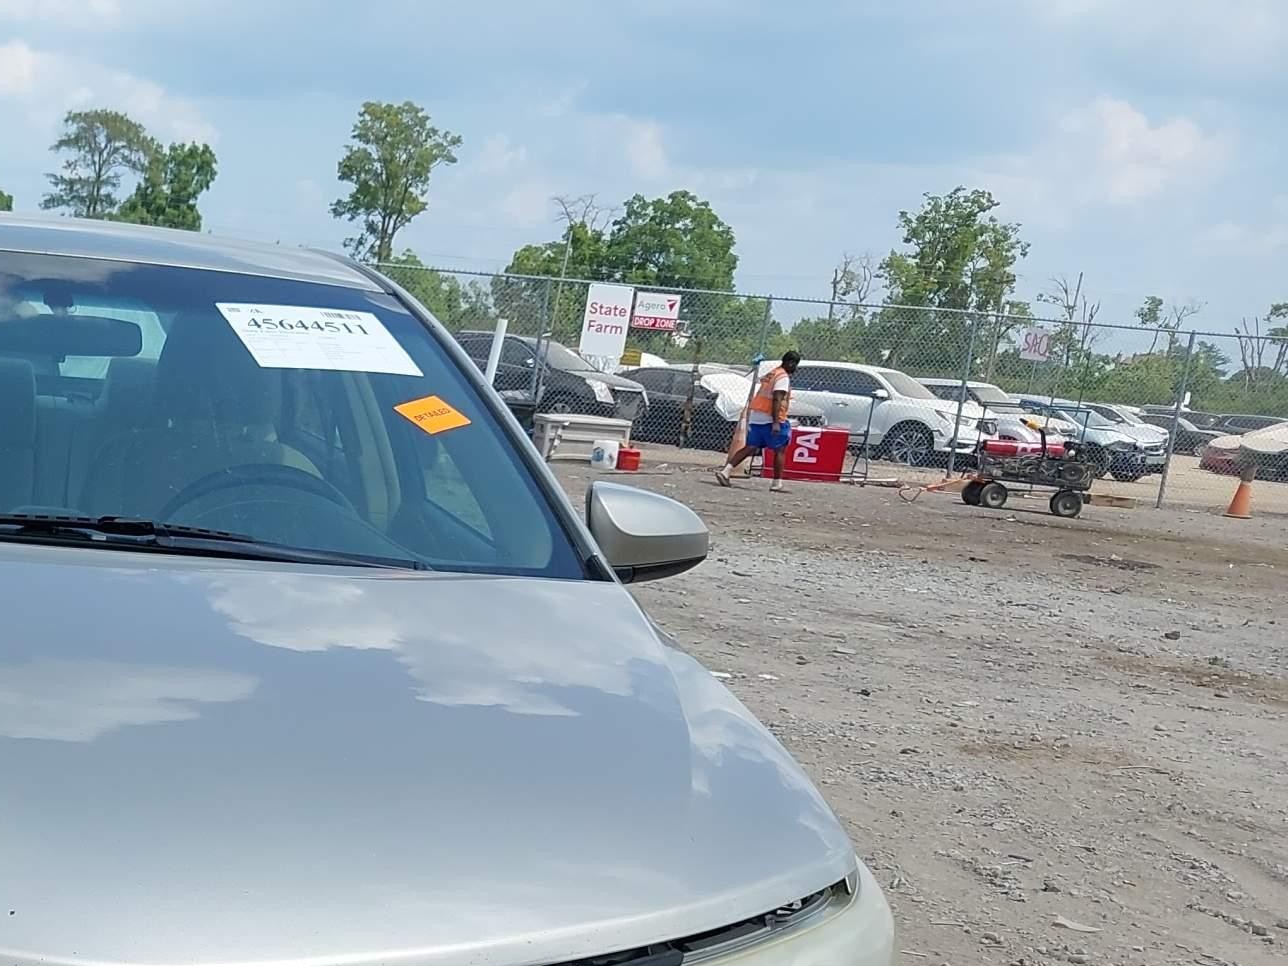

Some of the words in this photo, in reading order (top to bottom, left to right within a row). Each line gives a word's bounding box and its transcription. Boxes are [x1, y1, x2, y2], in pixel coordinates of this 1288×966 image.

[589, 301, 627, 317] State
[637, 300, 666, 312] Agero
[246, 317, 370, 336] 45644511
[587, 319, 623, 335] Farm
[634, 316, 655, 327] DROP
[655, 318, 676, 329] ZONE
[793, 426, 822, 463] PA
